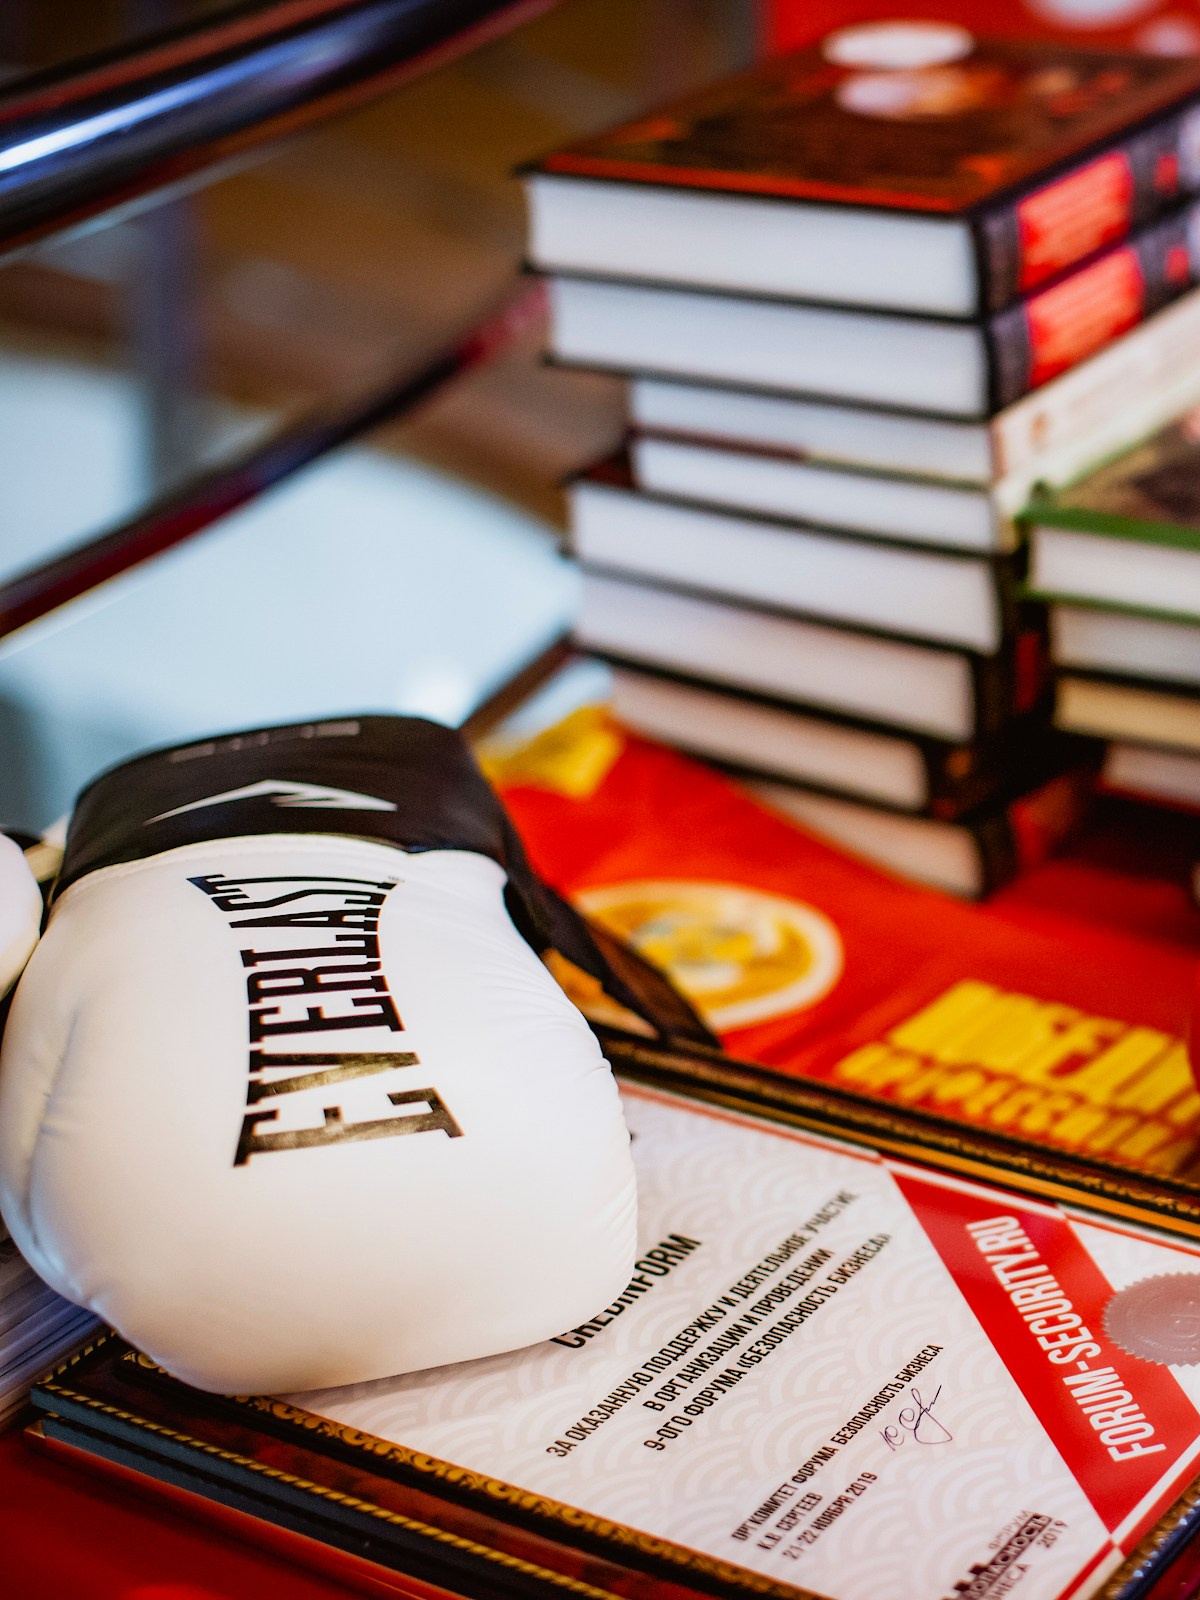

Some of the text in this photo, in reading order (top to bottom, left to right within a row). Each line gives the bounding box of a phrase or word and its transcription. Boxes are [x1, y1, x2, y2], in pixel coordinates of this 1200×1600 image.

[186, 867, 464, 1167] EVERLAST
[545, 1189, 860, 1458] ЗА ОКАЗАННУЮ ПОДДЕРЖКУ И ДЕЯТЕЛЬНОЕ УЧАСТИЕ
[642, 1248, 835, 1412] В ОРГАНИЗАЦИИ И ПРОВЕДЕНИИ
[643, 1233, 892, 1453] 9-ОГО ФОРУМА «БЕЗОПАСНОСТЬ БИЗНЕСА»
[966, 1216, 1166, 1461] FORUM-SECURITY.RU
[731, 1483, 799, 1542] ОРГКОМИТЕТ
[792, 1446, 839, 1485] ФОРУМА
[831, 1375, 905, 1445] БЕЗОПАСНОСТЬ
[894, 1344, 944, 1383] БИЗНЕСА
[775, 1492, 824, 1533] СЕРГЕЕВ
[810, 1489, 857, 1538] НОЯБРЯ
[845, 1472, 878, 1502] 2019
[1036, 1520, 1069, 1549] 2019
